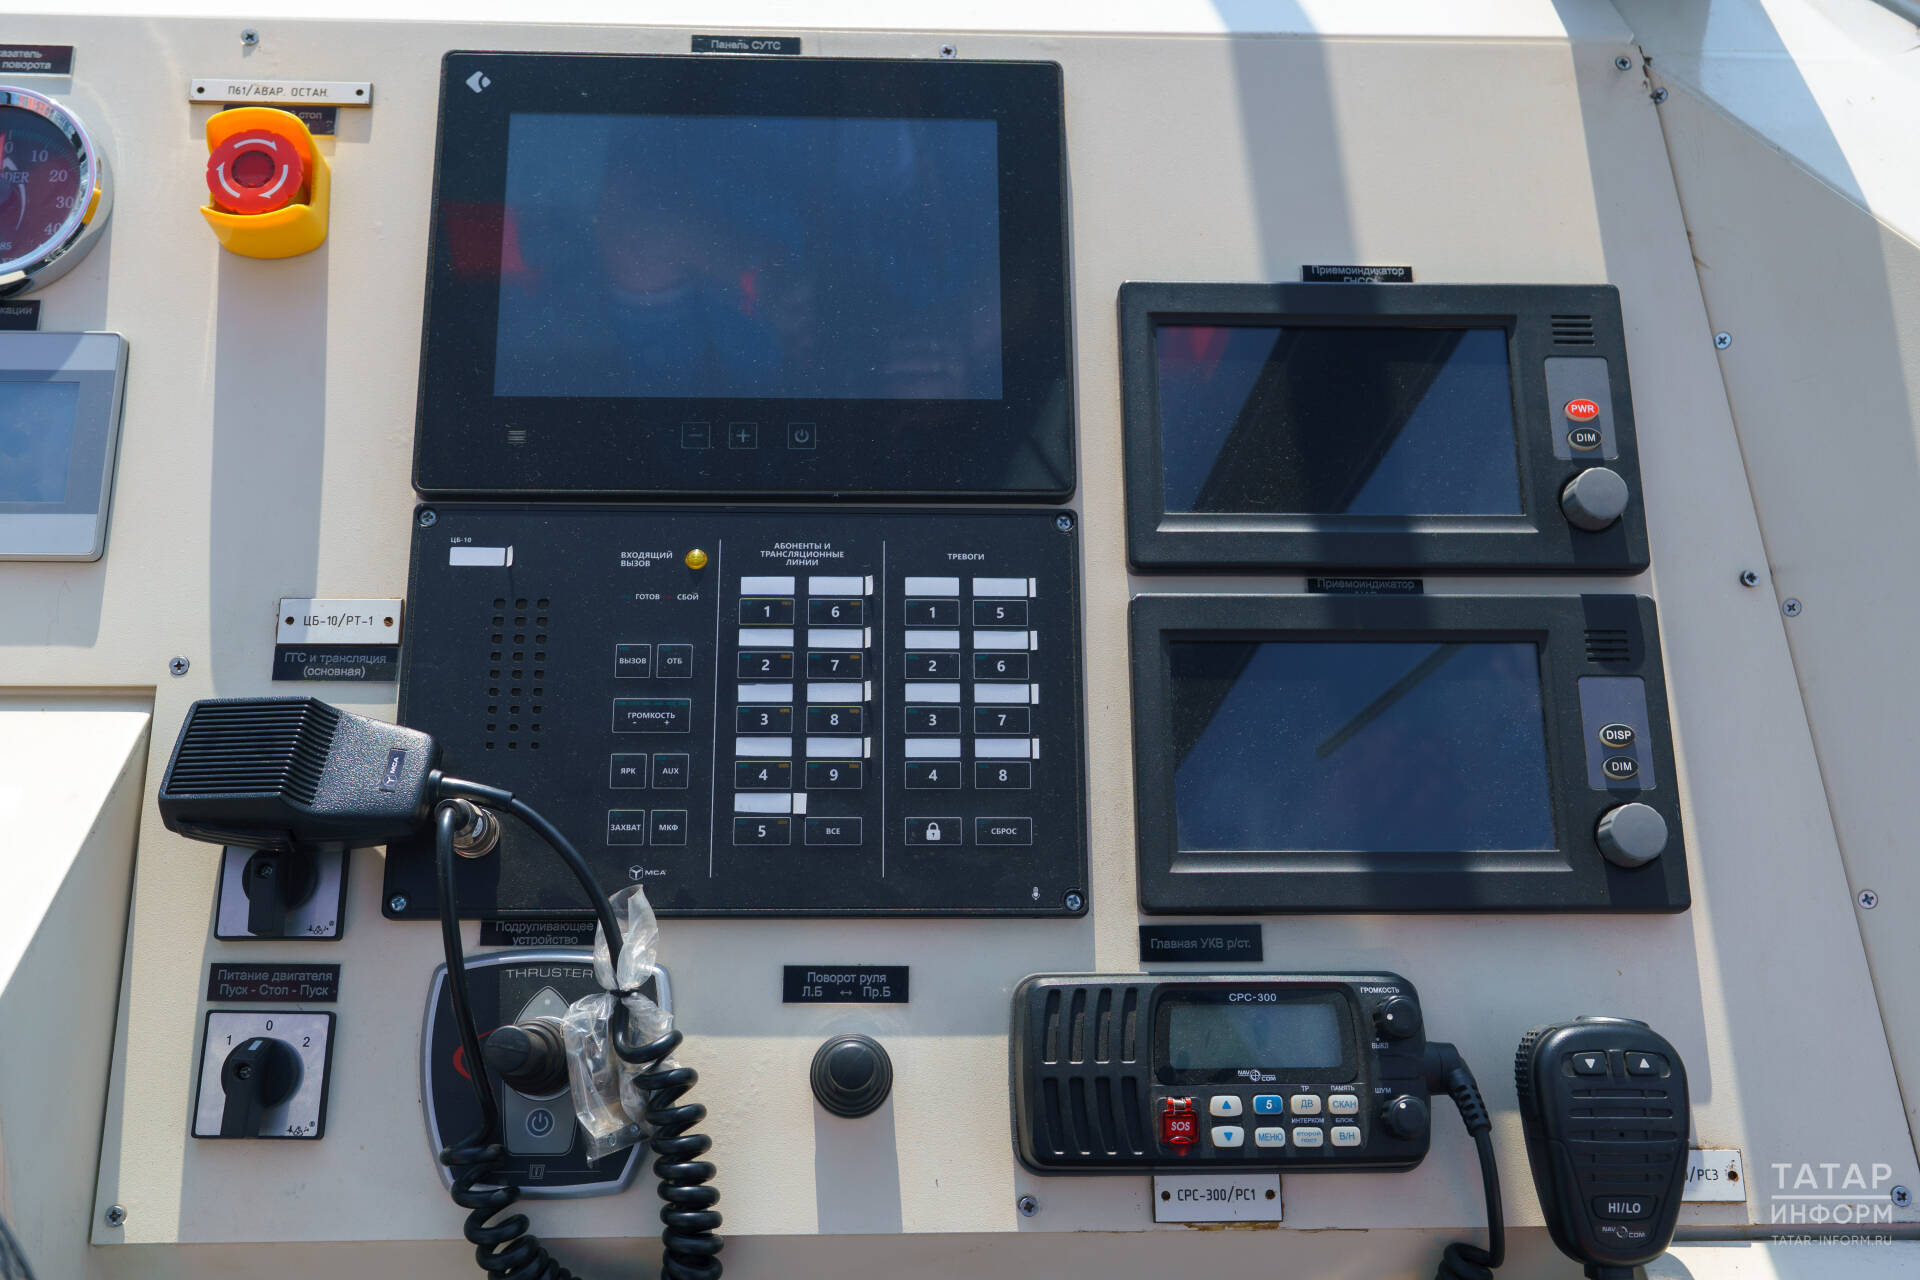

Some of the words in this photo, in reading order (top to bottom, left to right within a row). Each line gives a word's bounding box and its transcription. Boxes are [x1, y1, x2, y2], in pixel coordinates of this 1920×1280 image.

[711, 40, 749, 50] Панель
[751, 41, 782, 50] СУТС
[2, 61, 52, 71] поворота
[31, 150, 49, 162] 10
[49, 169, 68, 183] 20
[56, 196, 74, 209] 30
[44, 222, 62, 235] 40
[1571, 404, 1595, 413] PWR
[1577, 433, 1596, 442] DIM
[621, 551, 673, 559] ВХОДЯЩИЙ
[677, 592, 699, 600] СБОЙ
[764, 606, 770, 617] 1
[831, 606, 840, 618] 6
[929, 607, 936, 619] 1
[996, 607, 1005, 619] 5
[303, 613, 374, 627] ЦБ-10/РТ-1
[309, 654, 316, 662] и
[320, 653, 387, 665] трансляция
[761, 660, 770, 671] 2
[830, 660, 840, 671] 7
[928, 660, 937, 672] 2
[997, 660, 1006, 672] 6
[303, 665, 366, 679] (основная)
[760, 714, 769, 725] 3
[830, 714, 839, 726] 8
[928, 714, 937, 726] 3
[997, 714, 1007, 726] 7
[1606, 730, 1632, 739] DISP
[1612, 761, 1633, 771] DIM
[758, 769, 768, 780] 4
[829, 769, 839, 781] 9
[928, 769, 938, 781] 4
[998, 769, 1008, 781] 8
[758, 825, 766, 837] 5
[991, 827, 1017, 835] СБРОС
[496, 921, 594, 934] Подруливающее
[513, 935, 579, 946] устройство
[1150, 938, 1198, 949] Главная
[1200, 938, 1224, 949] УКВ
[217, 969, 268, 981] Питание
[271, 971, 333, 983] двигателя
[505, 967, 594, 979] THRUSTER
[808, 972, 857, 985] Поворот
[860, 974, 887, 986] руля
[219, 984, 248, 999] Пуск
[259, 984, 289, 996] Стоп
[300, 984, 329, 999] Пуск
[802, 986, 823, 997] Л.Б
[863, 986, 891, 999] Пр.Б
[266, 1020, 274, 1031] 0
[226, 1035, 233, 1046] 1
[303, 1036, 311, 1048] 2
[1266, 1099, 1273, 1109] 5
[1301, 1100, 1314, 1109] ДВ
[1333, 1100, 1357, 1109] СКАН
[1171, 1121, 1190, 1131] SOS
[1258, 1132, 1283, 1142] МЕНЮ
[1608, 1202, 1641, 1213] HI/LO
